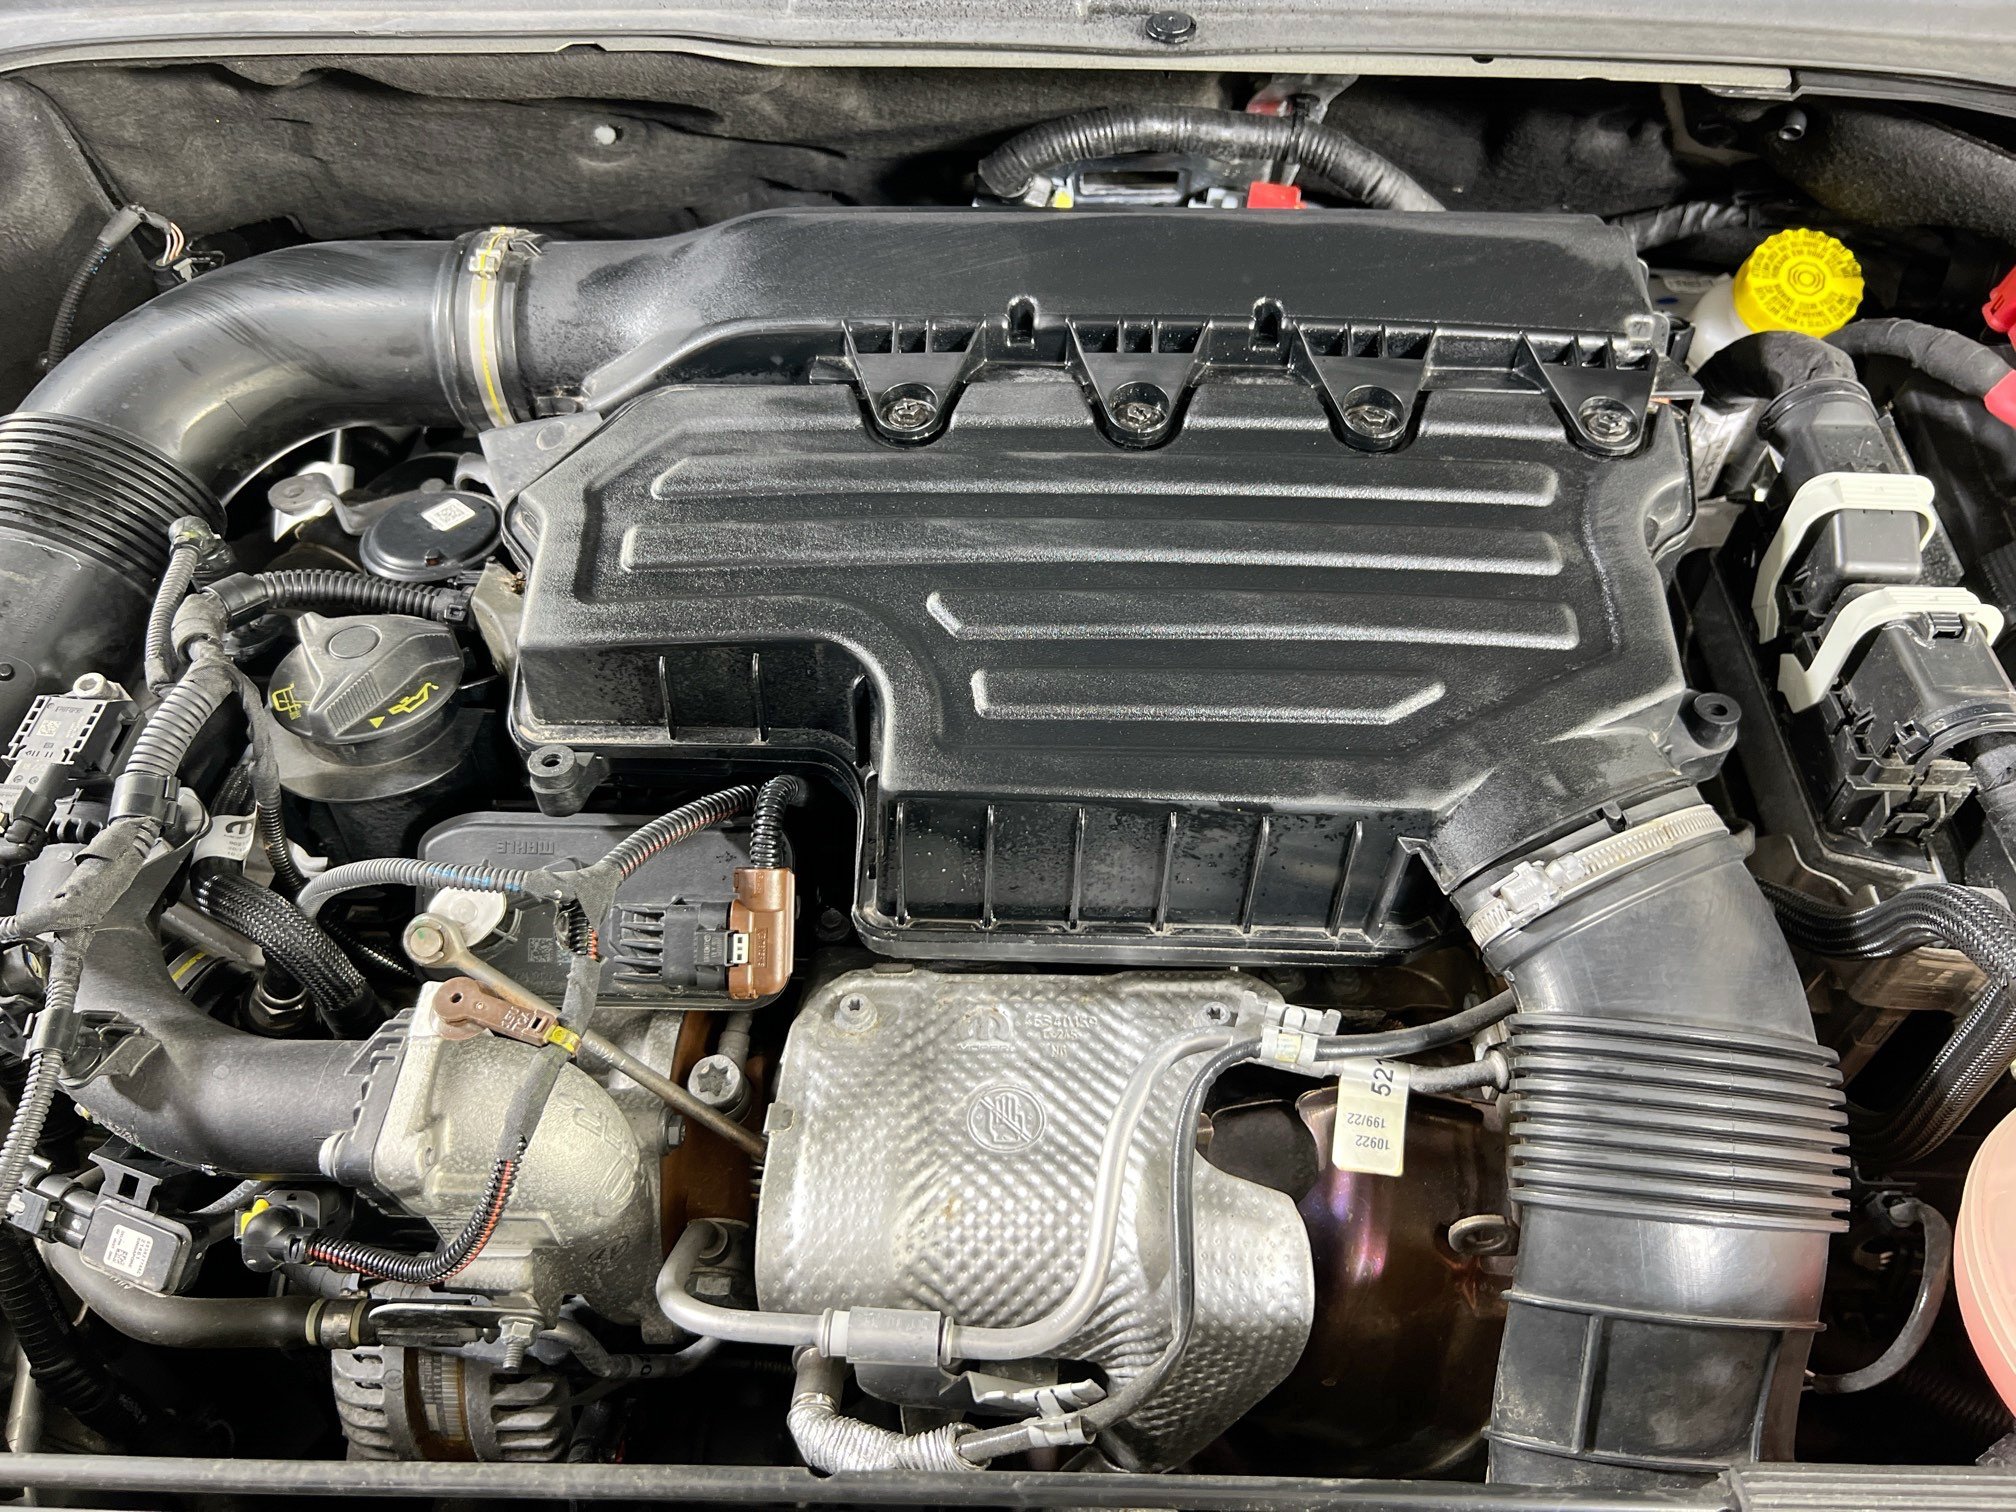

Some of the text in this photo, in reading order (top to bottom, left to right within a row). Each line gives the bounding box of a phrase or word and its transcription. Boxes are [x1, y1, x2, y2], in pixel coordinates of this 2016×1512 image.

[497, 840, 555, 856] MAHLE
[1346, 1112, 1386, 1129] 199/22
[1355, 1134, 1391, 1150] 10922
